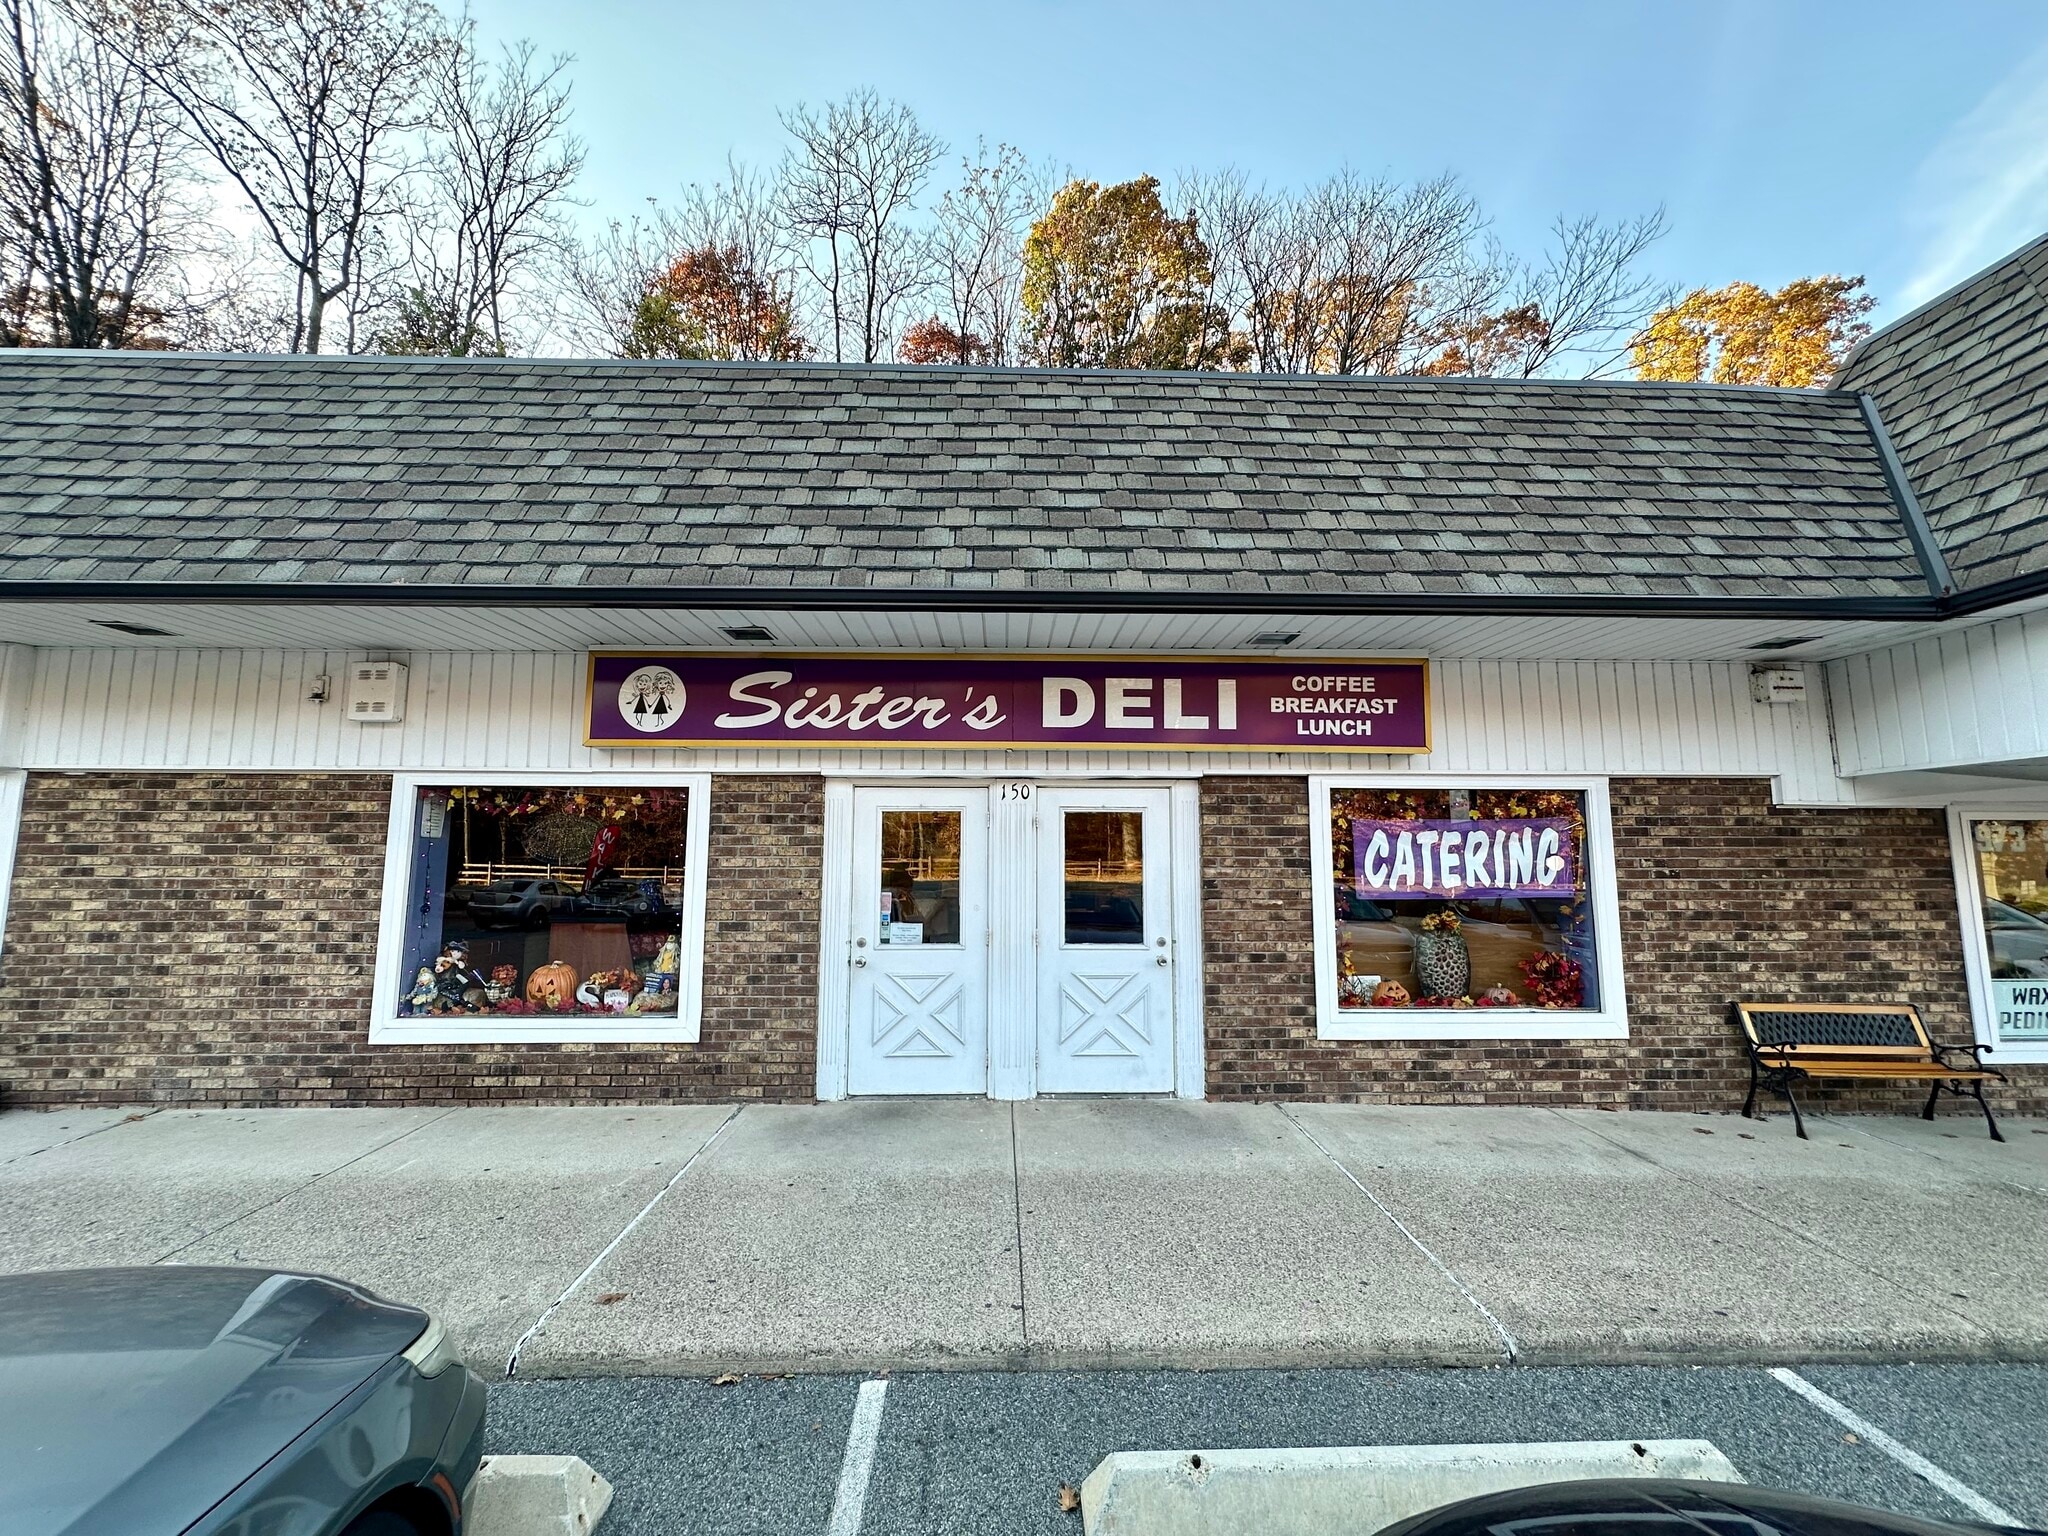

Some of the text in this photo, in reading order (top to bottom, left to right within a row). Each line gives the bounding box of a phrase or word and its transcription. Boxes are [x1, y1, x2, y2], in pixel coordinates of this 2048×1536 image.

[1291, 675, 1376, 693] COFFEE
[714, 670, 1237, 730] Sister's DELI
[1270, 697, 1398, 714] BREAKFAST
[1297, 718, 1371, 736] LUNCH
[1001, 783, 1030, 801] 150
[1364, 826, 1560, 891] CATERING
[1999, 1011, 2048, 1030] PEDI
